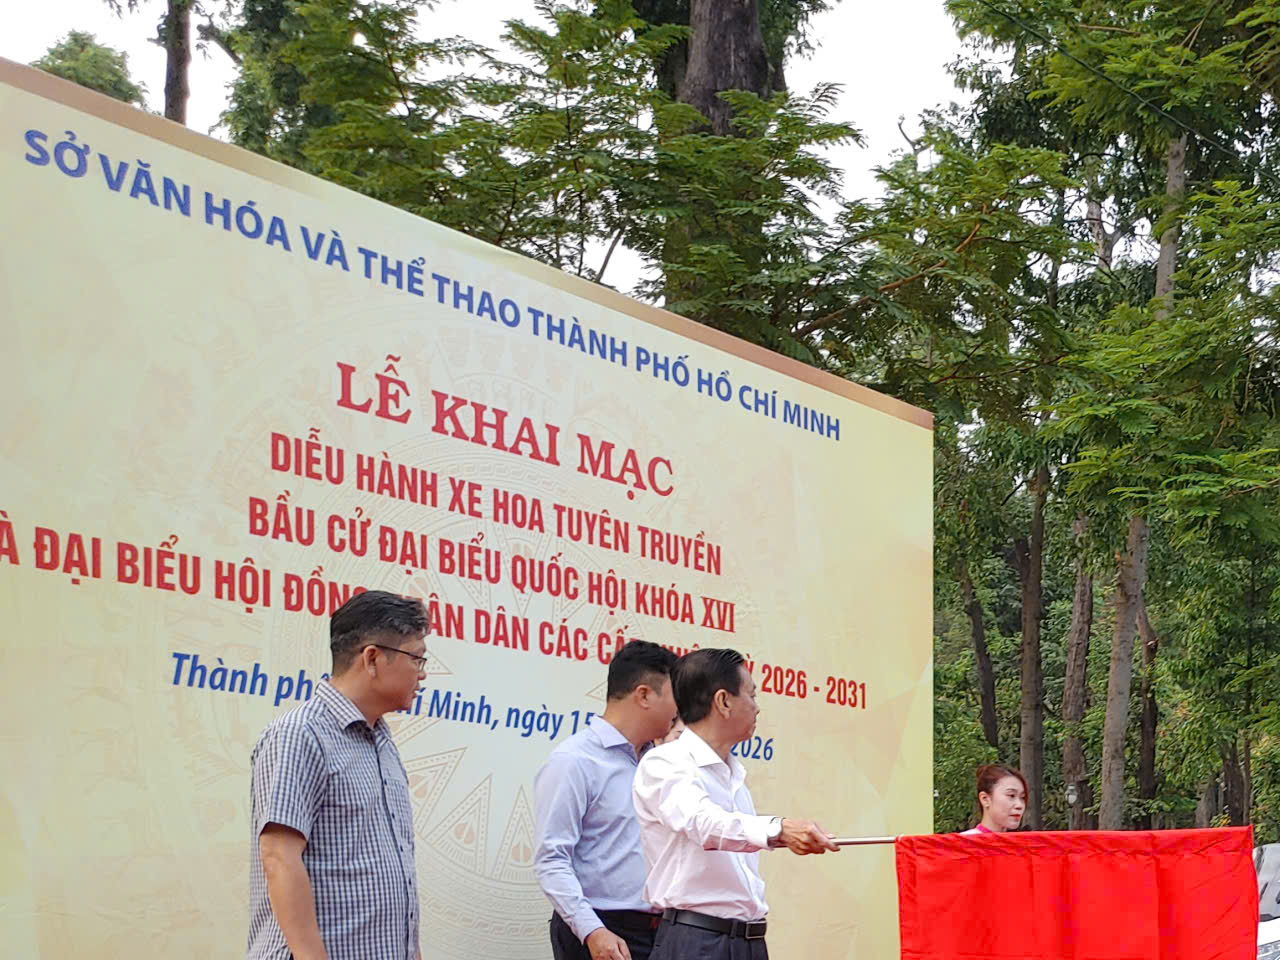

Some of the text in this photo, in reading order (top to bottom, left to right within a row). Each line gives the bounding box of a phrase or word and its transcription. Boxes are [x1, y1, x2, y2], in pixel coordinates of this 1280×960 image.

[24, 130, 841, 441] SỞ VĂN HÓA VÀ THỂ THAO THÀNH PHỐ HỒ CHÍ MINH
[337, 355, 674, 500] LỄ KHAI MẠC
[249, 490, 736, 633] BẦU CỬ ĐẠI BIỂU QUỐC HỘI KHÓA XVI
[271, 428, 721, 576] DIỄU HÀNH XE HOA TUYÊN TRUYỀN
[34, 526, 102, 585] ĐẠI
[117, 534, 201, 595] BIỂU
[214, 557, 271, 614] HỘI
[283, 565, 369, 618] ĐỒN
[475, 605, 529, 651] DÂN
[539, 618, 588, 661] CÁC
[598, 625, 638, 665] CẤ
[761, 663, 807, 699] 2026
[826, 676, 866, 709] 2031
[172, 652, 268, 697] Thành
[274, 669, 332, 706] ph
[428, 690, 499, 730] Minh,
[505, 704, 563, 740] ngày
